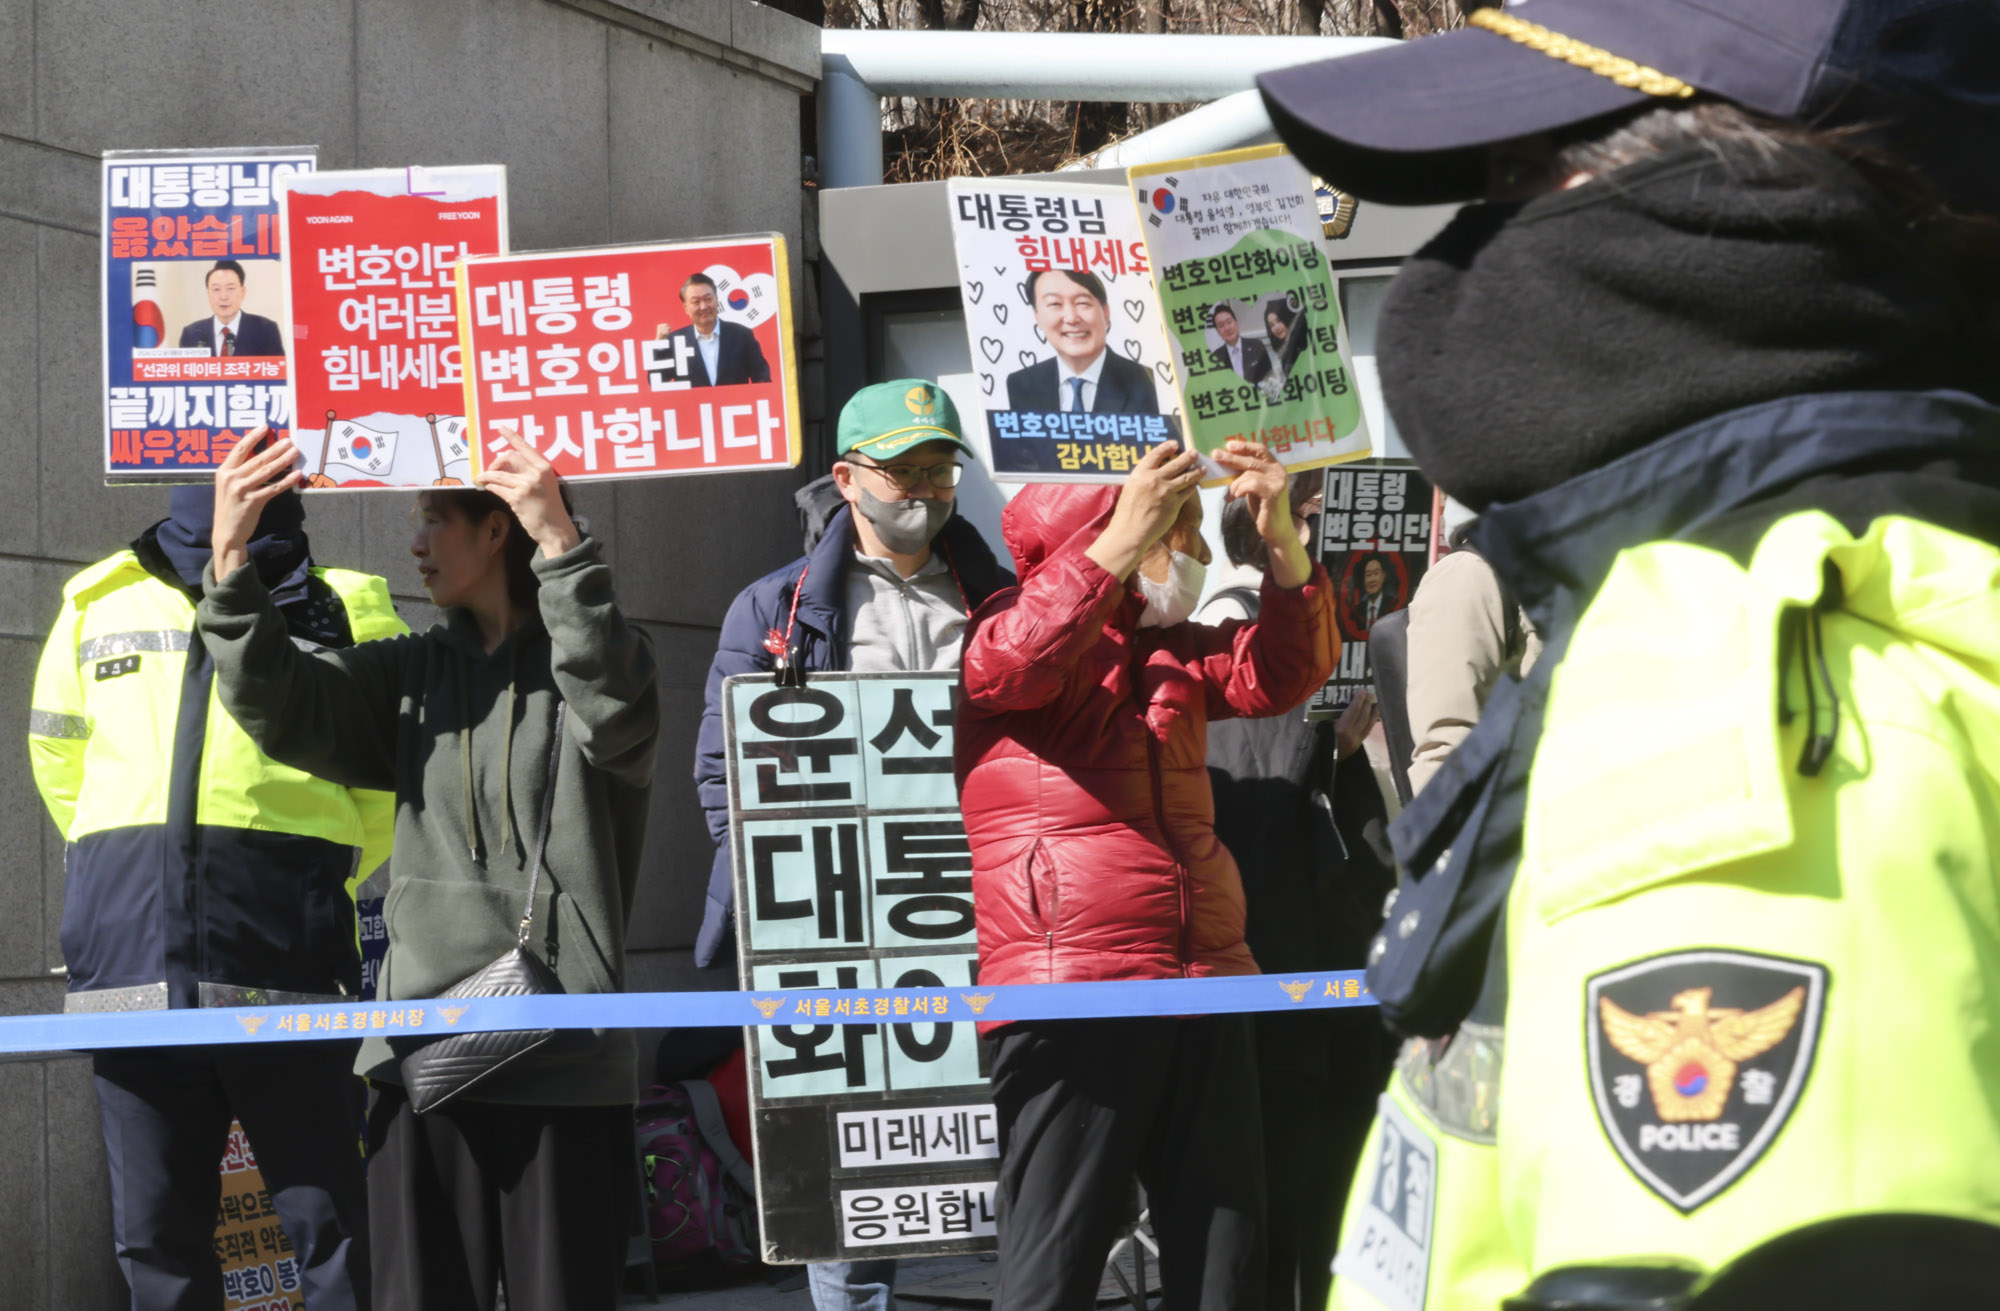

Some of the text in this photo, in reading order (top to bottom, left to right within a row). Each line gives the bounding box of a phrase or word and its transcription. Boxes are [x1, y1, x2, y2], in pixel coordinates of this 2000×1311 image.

[957, 193, 1106, 235] 대통령님
[1175, 209, 1203, 226] 대통령
[111, 213, 281, 258] 옳았습니
[1192, 226, 1220, 240] 끝까지
[1162, 241, 1320, 292] 변호인단화이팅
[338, 294, 456, 340] 여러분
[475, 272, 633, 336] 대통령
[183, 362, 221, 377] 데이터
[224, 361, 251, 377] 조작
[321, 344, 464, 390] 힘내세요
[480, 335, 695, 402] 변호인단
[993, 411, 1168, 442] 변호인단여러분
[1224, 416, 1336, 454] 합니다
[110, 428, 291, 465] 싸우겠습
[1056, 443, 1156, 471] 감사합니
[1327, 471, 1407, 511] 대통령
[1323, 512, 1430, 552] 변호인단
[794, 996, 950, 1017] 서울서초경찰서장
[1323, 979, 1369, 999] 서울
[277, 1008, 426, 1032] 서울서초경찰서장
[1638, 1123, 1741, 1151] POLICE
